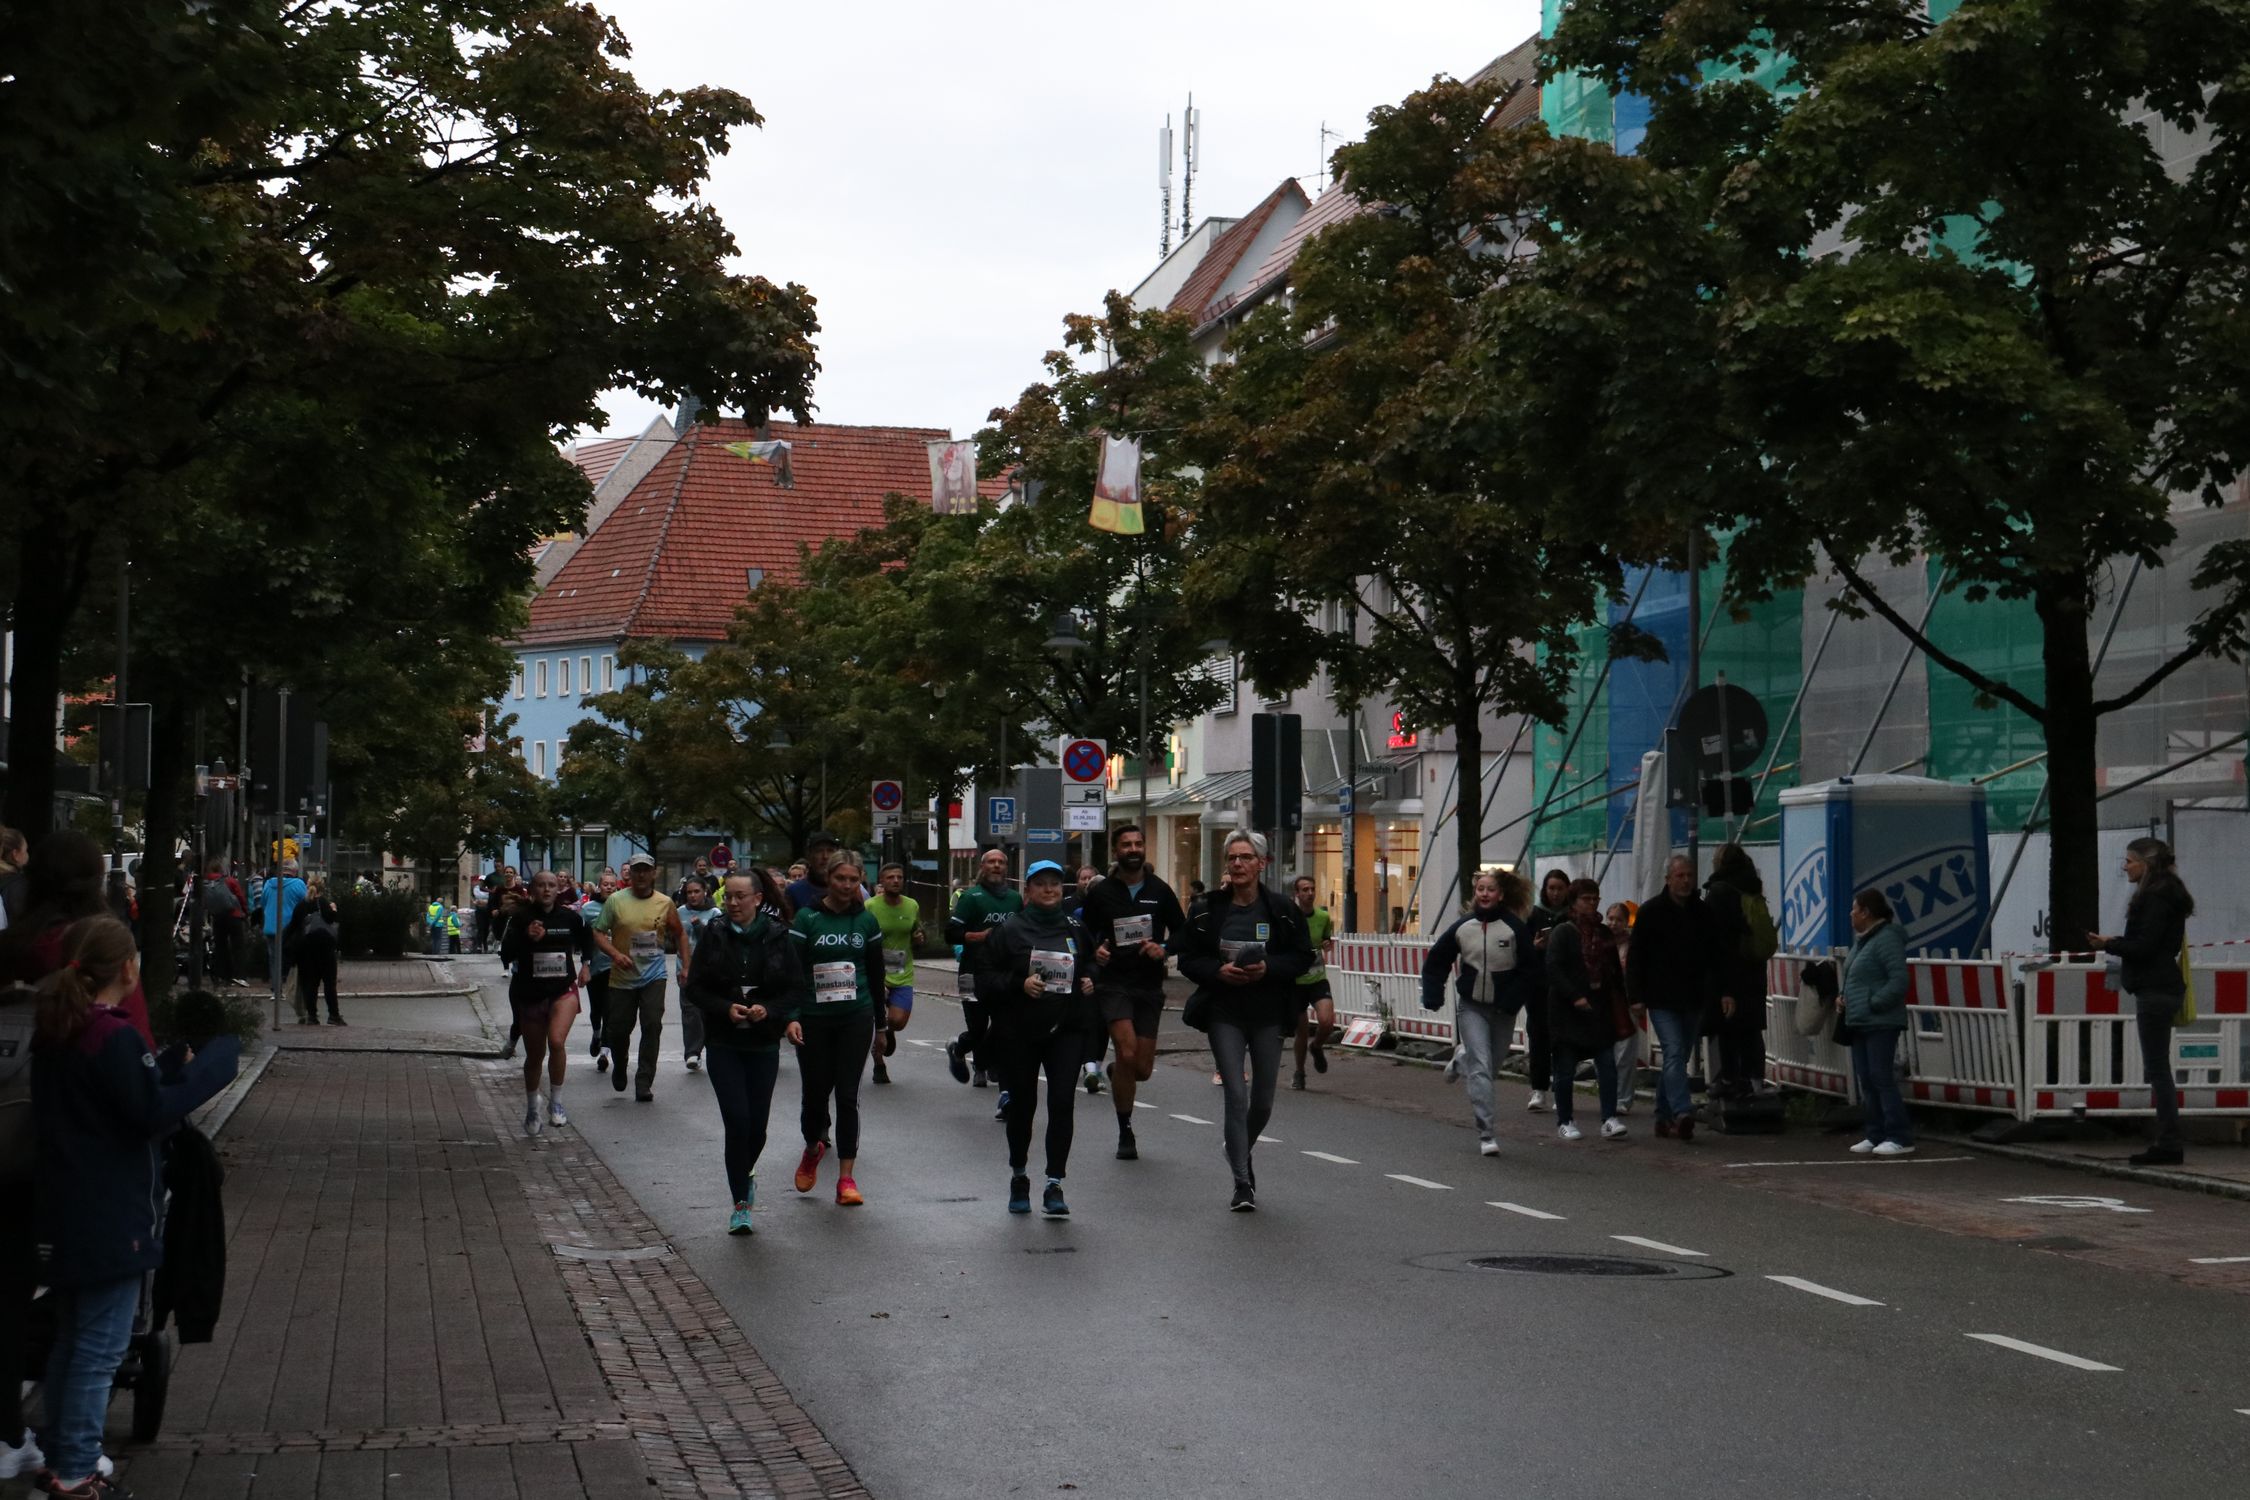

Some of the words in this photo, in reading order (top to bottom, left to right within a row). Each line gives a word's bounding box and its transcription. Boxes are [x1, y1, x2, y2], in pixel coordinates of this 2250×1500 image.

[995, 801, 1009, 820] P
[983, 912, 1007, 923] AOK
[815, 934, 849, 946] AOK
[816, 980, 855, 989] Anastasija
